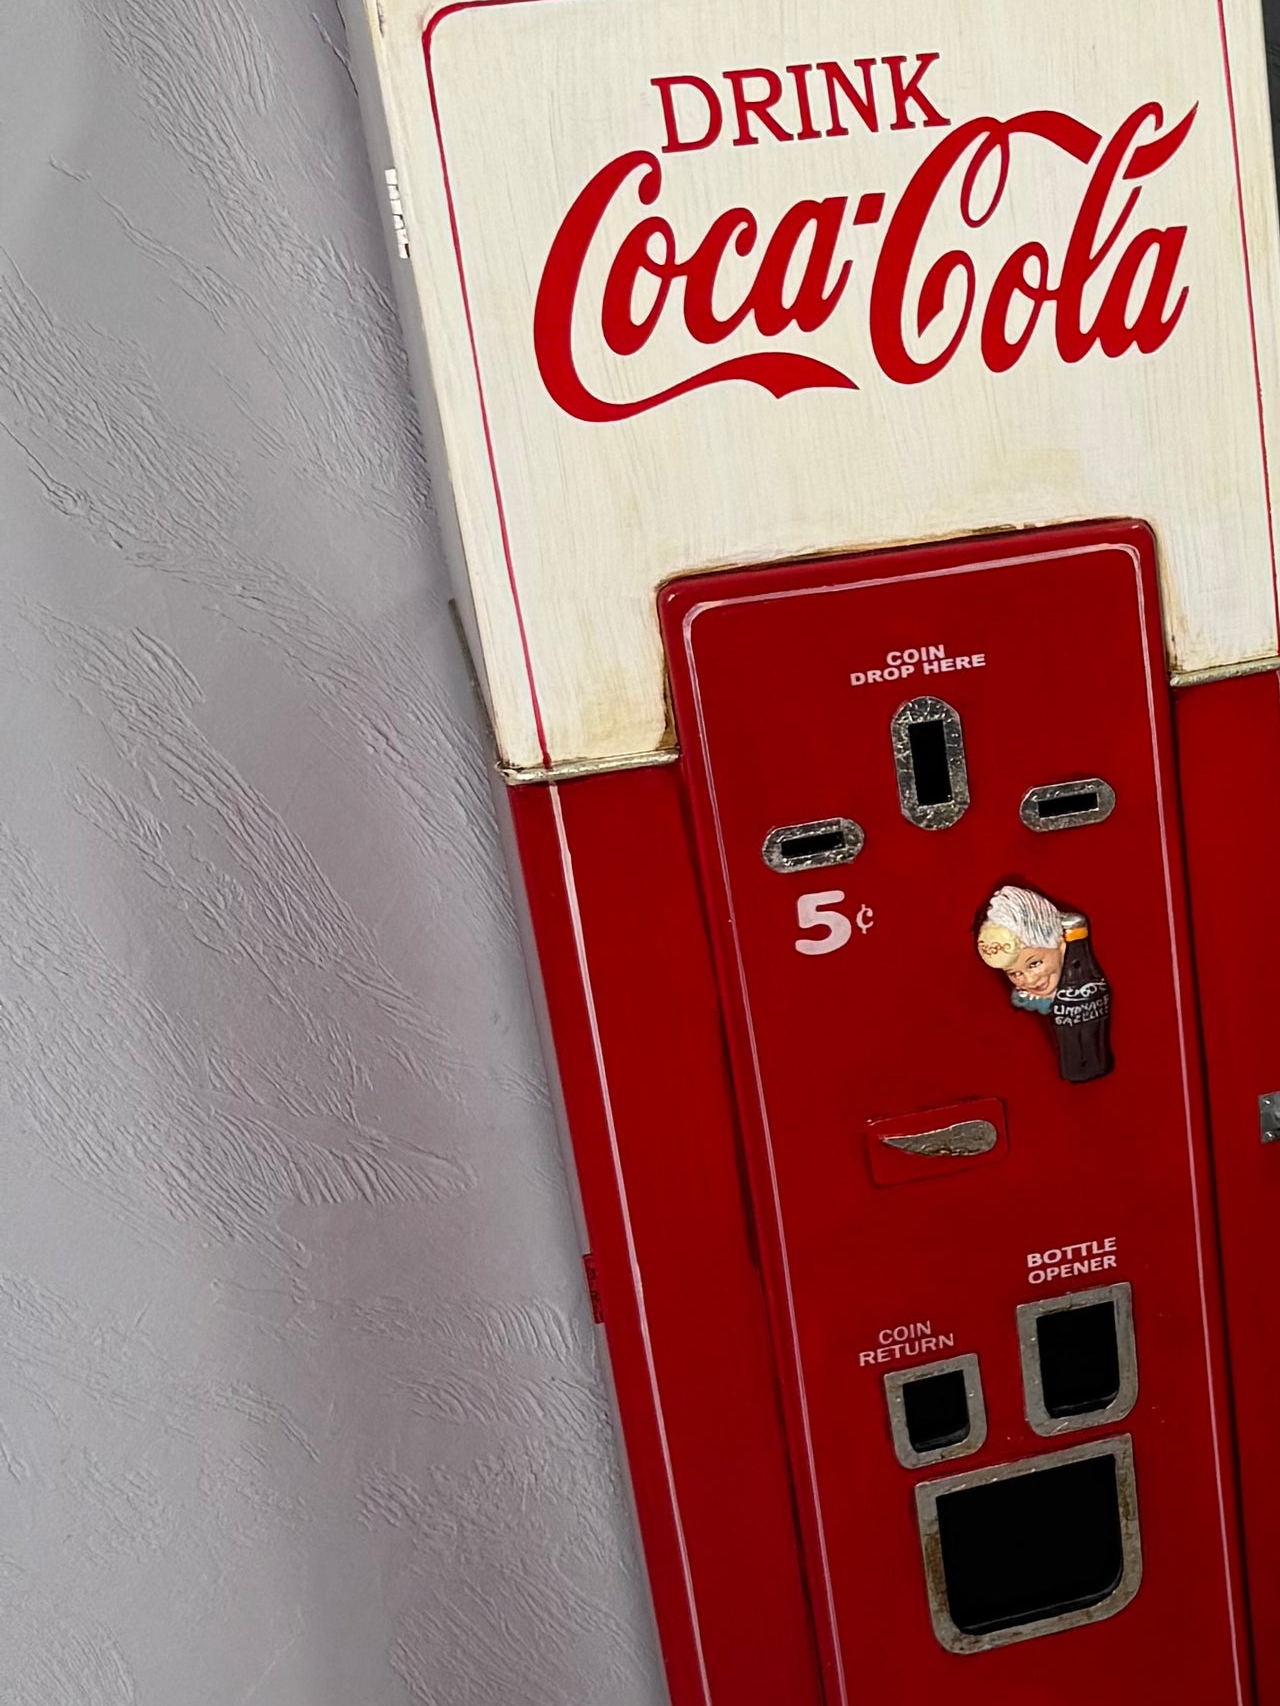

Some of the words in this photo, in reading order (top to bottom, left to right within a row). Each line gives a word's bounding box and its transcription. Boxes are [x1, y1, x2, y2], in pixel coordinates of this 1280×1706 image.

[650, 51, 951, 154] DRINK
[533, 100, 1199, 423] Coca-Cola
[850, 665, 915, 686] DROP
[922, 653, 986, 675] HERE
[886, 644, 945, 666] COIN
[795, 890, 874, 955] 5¢
[1027, 1237, 1118, 1268] BOTTLE
[1028, 1255, 1118, 1285] OPENER
[878, 1320, 931, 1345] COIN
[858, 1333, 955, 1367] RETURN
